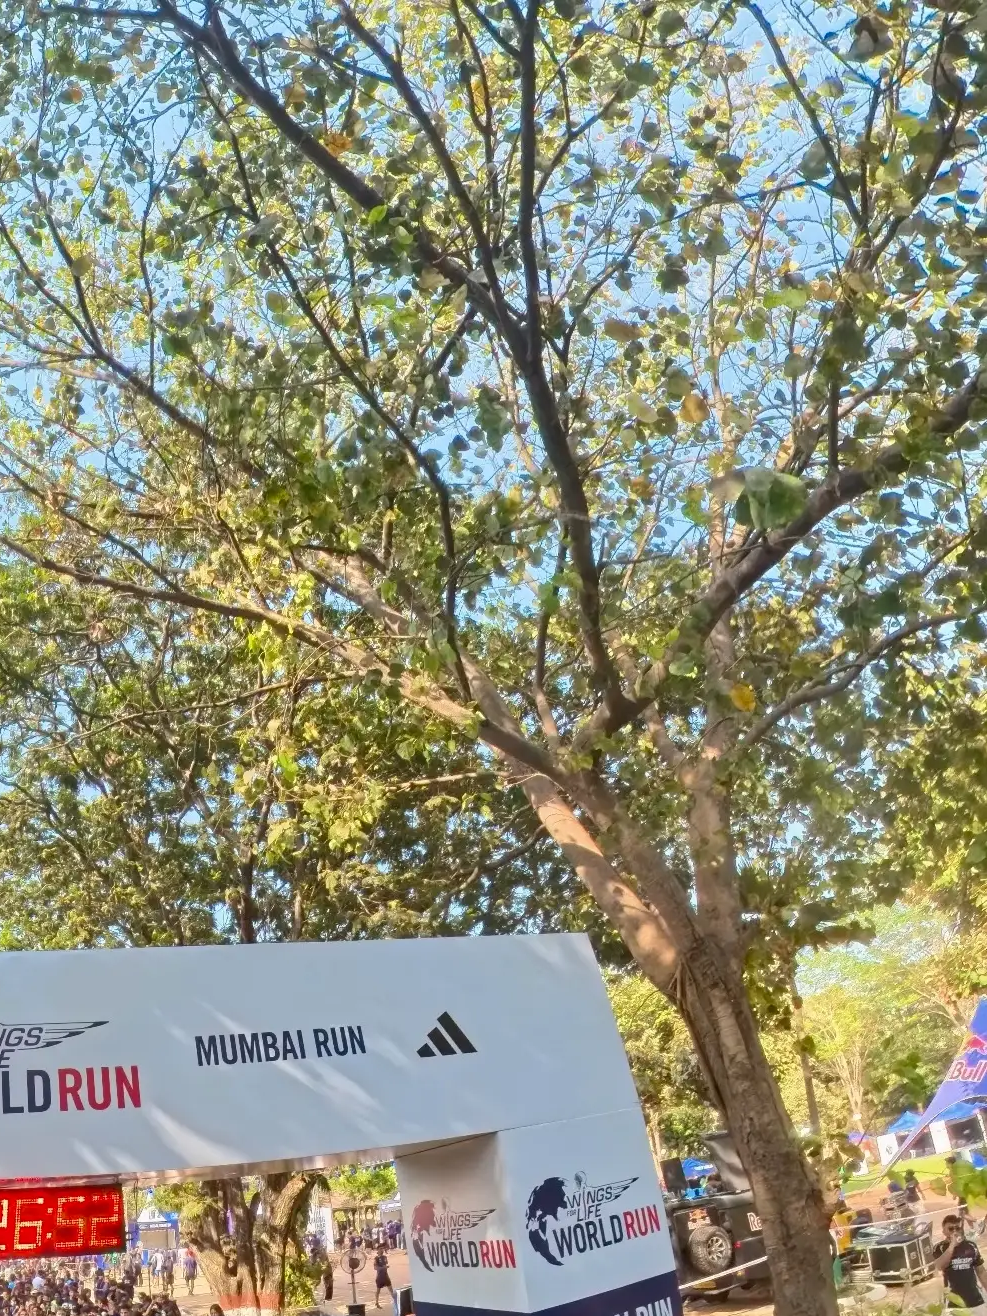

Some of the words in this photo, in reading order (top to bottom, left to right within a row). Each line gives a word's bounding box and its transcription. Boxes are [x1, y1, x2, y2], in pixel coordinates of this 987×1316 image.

[195, 1029, 307, 1067] MUMBAI
[313, 1025, 367, 1059] RUN
[948, 1059, 987, 1082] Bull
[58, 1065, 142, 1112] RUN
[565, 1186, 613, 1209] WINGS
[435, 1213, 471, 1229] WINGS
[576, 1204, 602, 1223] LIFE
[442, 1226, 462, 1241] LIFE
[553, 1214, 625, 1258] WORLD
[623, 1204, 661, 1241] RUN
[427, 1240, 480, 1269] WORLD
[480, 1239, 517, 1269] RUN
